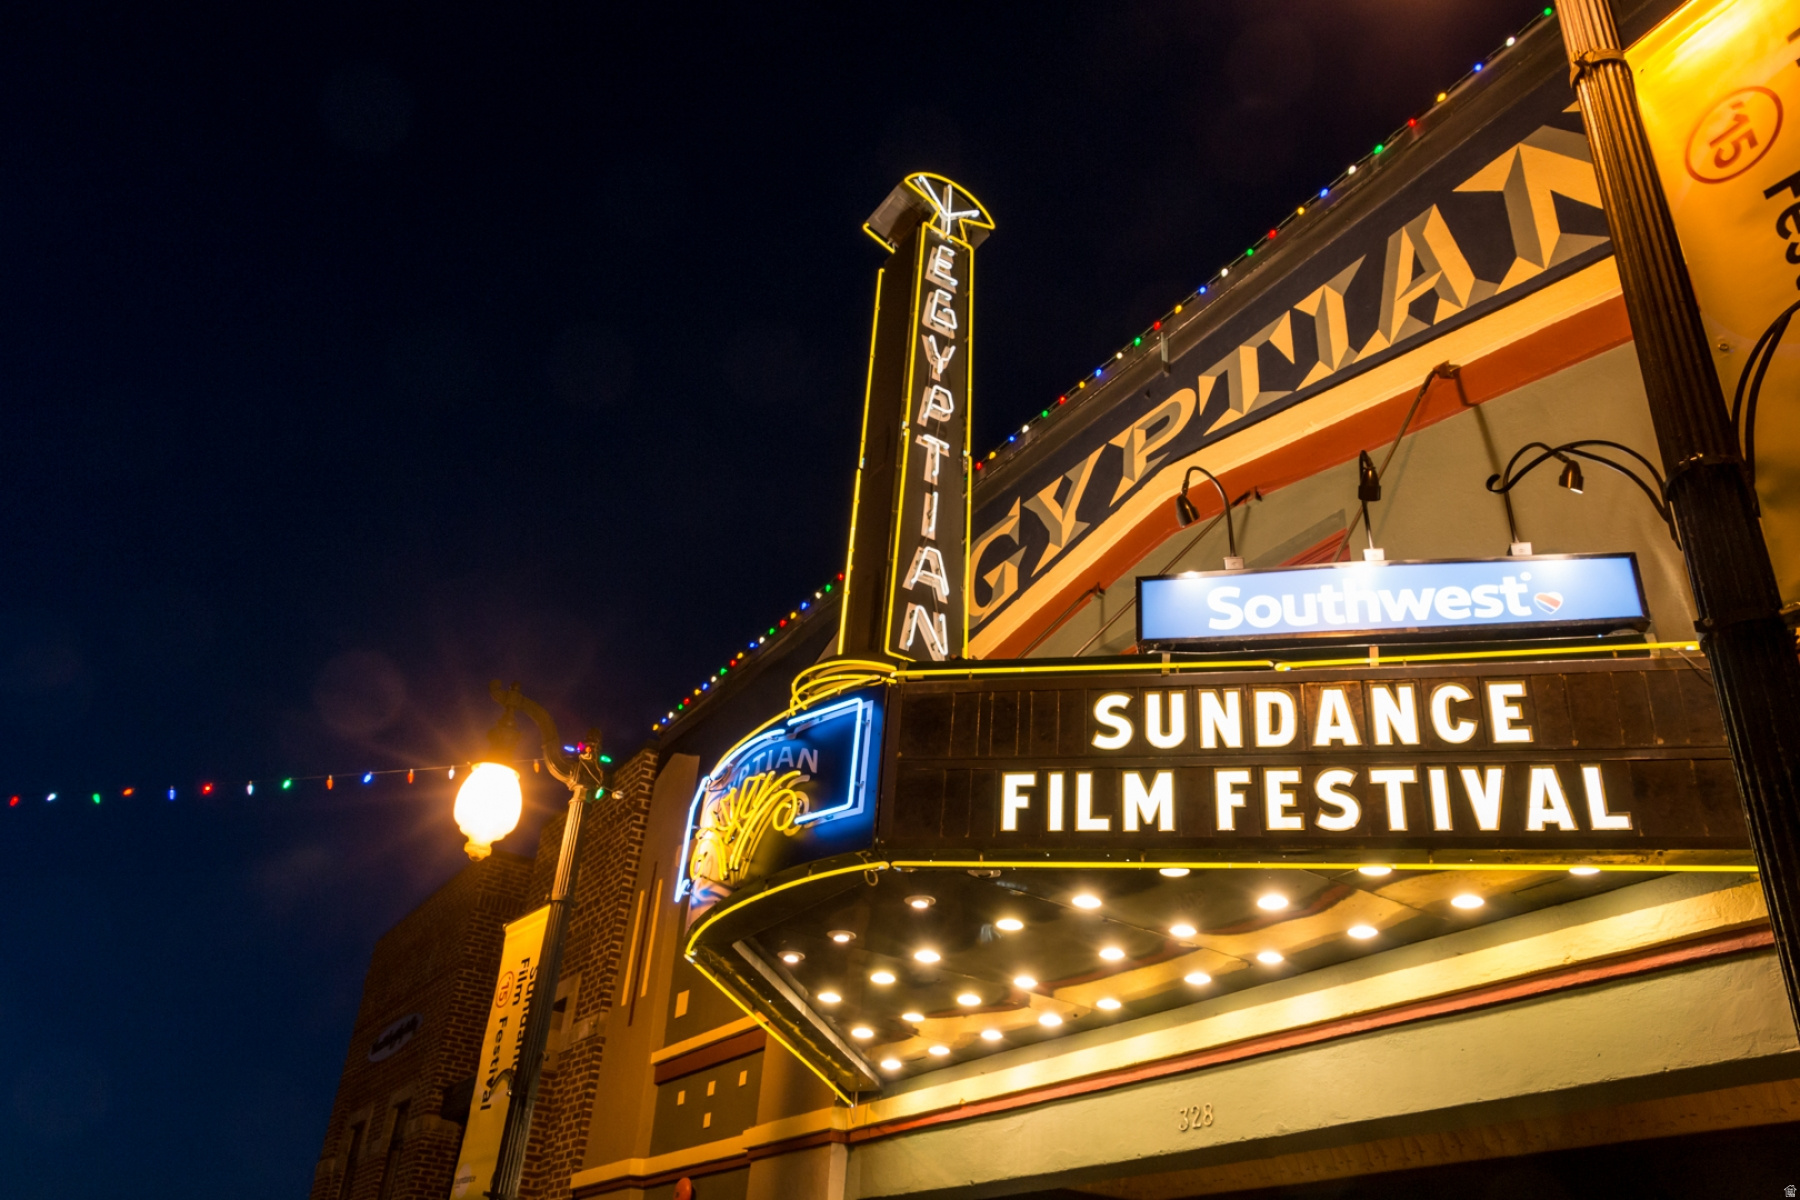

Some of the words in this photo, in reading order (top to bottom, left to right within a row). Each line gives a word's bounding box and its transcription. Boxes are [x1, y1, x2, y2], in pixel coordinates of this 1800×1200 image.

[967, 100, 1613, 622] GYPTIAN
[899, 245, 958, 662] EGYPTIAN
[1207, 573, 1533, 630] Southwest
[1091, 680, 1533, 750] SUNDANCE
[1001, 769, 1175, 832] FILM
[1214, 763, 1633, 832] FESTIVAL
[512, 957, 530, 1006] Film
[511, 965, 539, 1075] Sundanc
[480, 1015, 508, 1111] Festival
[1179, 1102, 1213, 1132] 328
